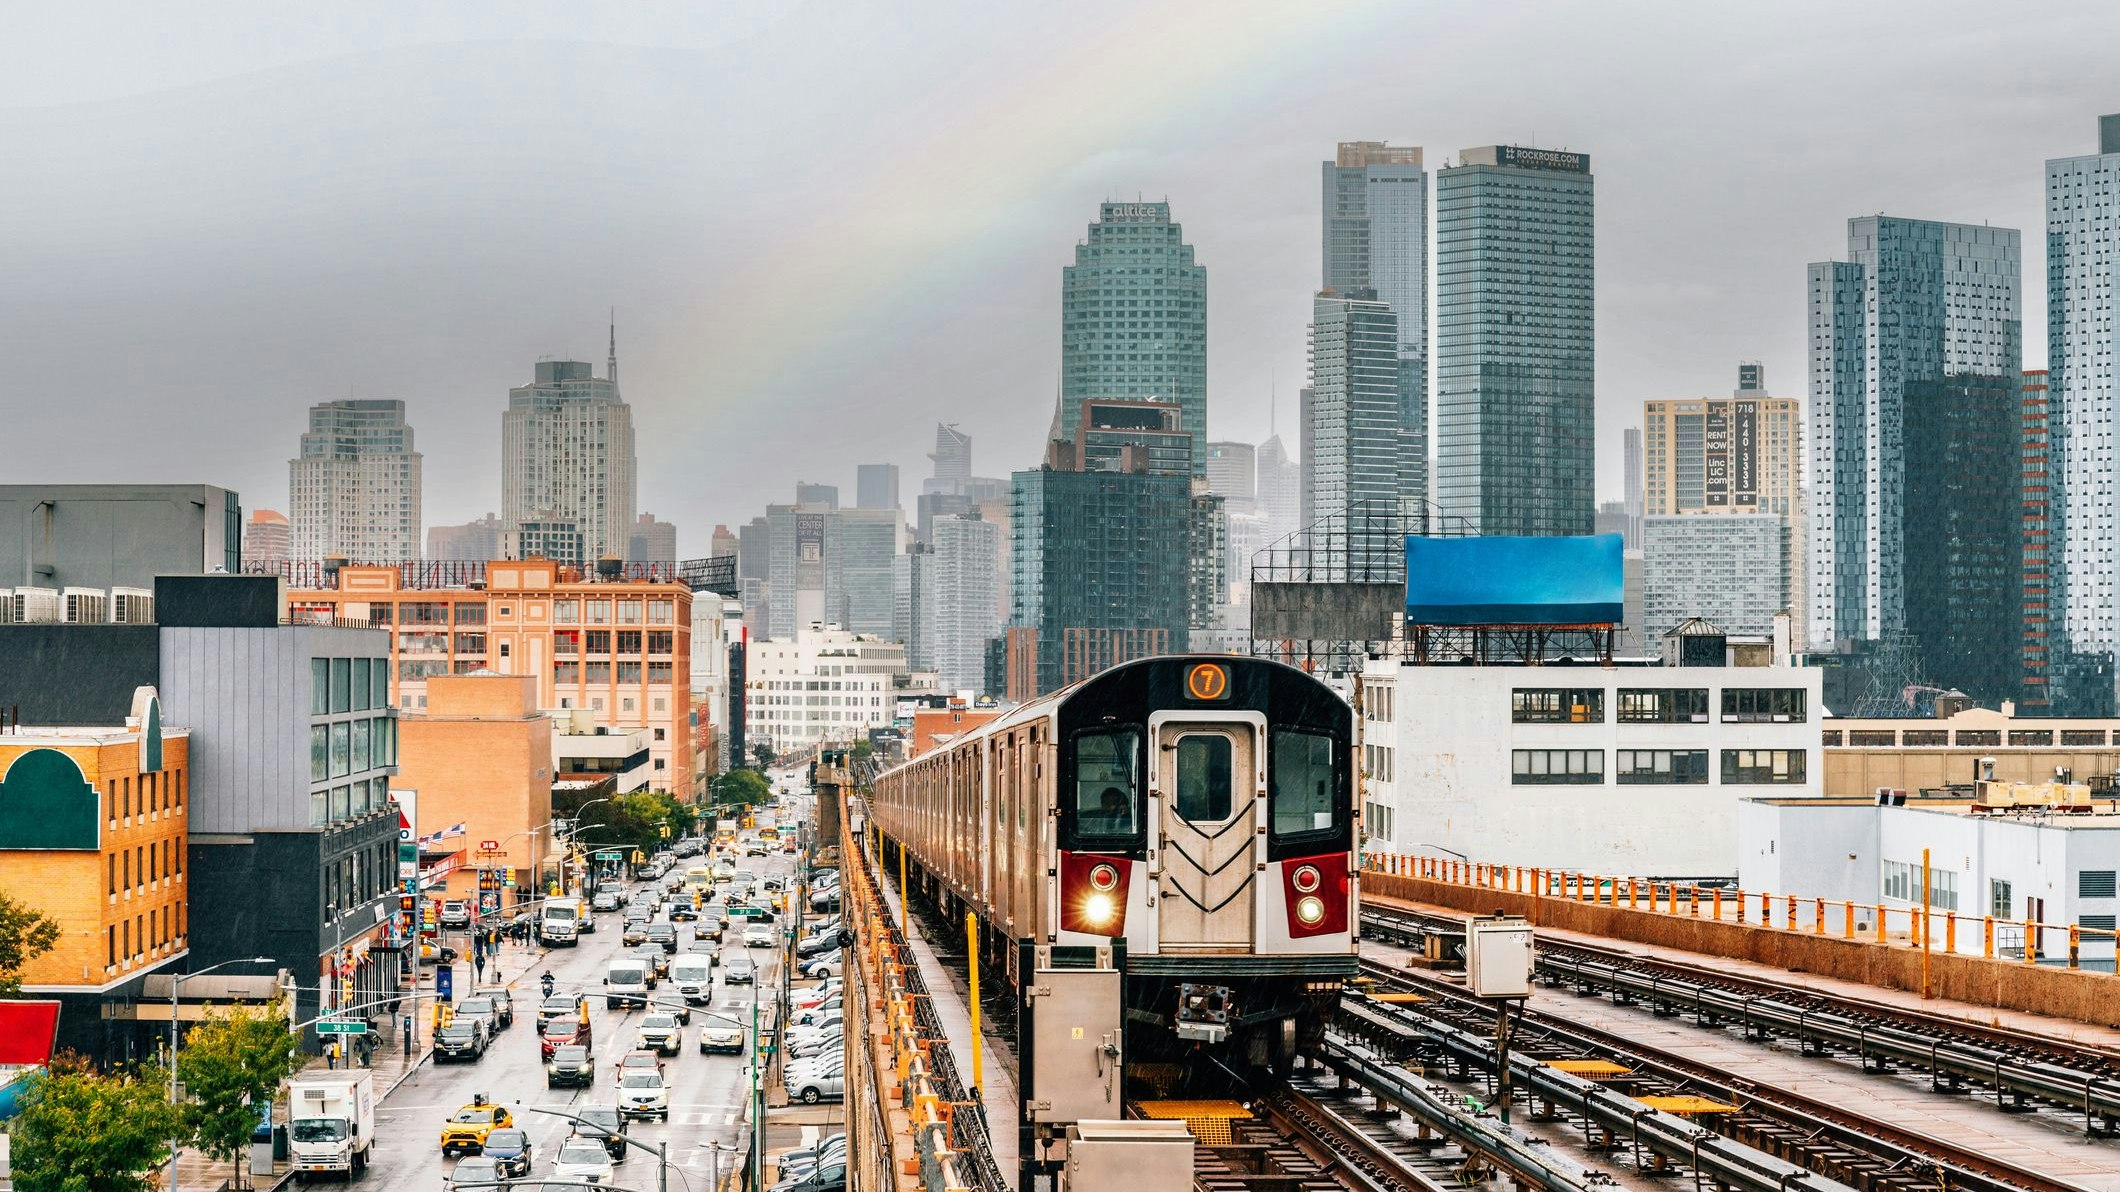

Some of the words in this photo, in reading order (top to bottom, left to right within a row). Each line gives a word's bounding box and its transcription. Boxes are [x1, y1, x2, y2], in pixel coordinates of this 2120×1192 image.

[1517, 149, 1579, 164] ROCKROSE.COM
[1113, 203, 1156, 217] altice
[1738, 404, 1754, 413] 718
[1707, 431, 1727, 439] RENT
[1707, 441, 1727, 449] NOW
[1709, 459, 1725, 467] Linc
[1710, 467, 1724, 476] LIC
[798, 520, 823, 529] CENTER
[1201, 670, 1214, 692] 7
